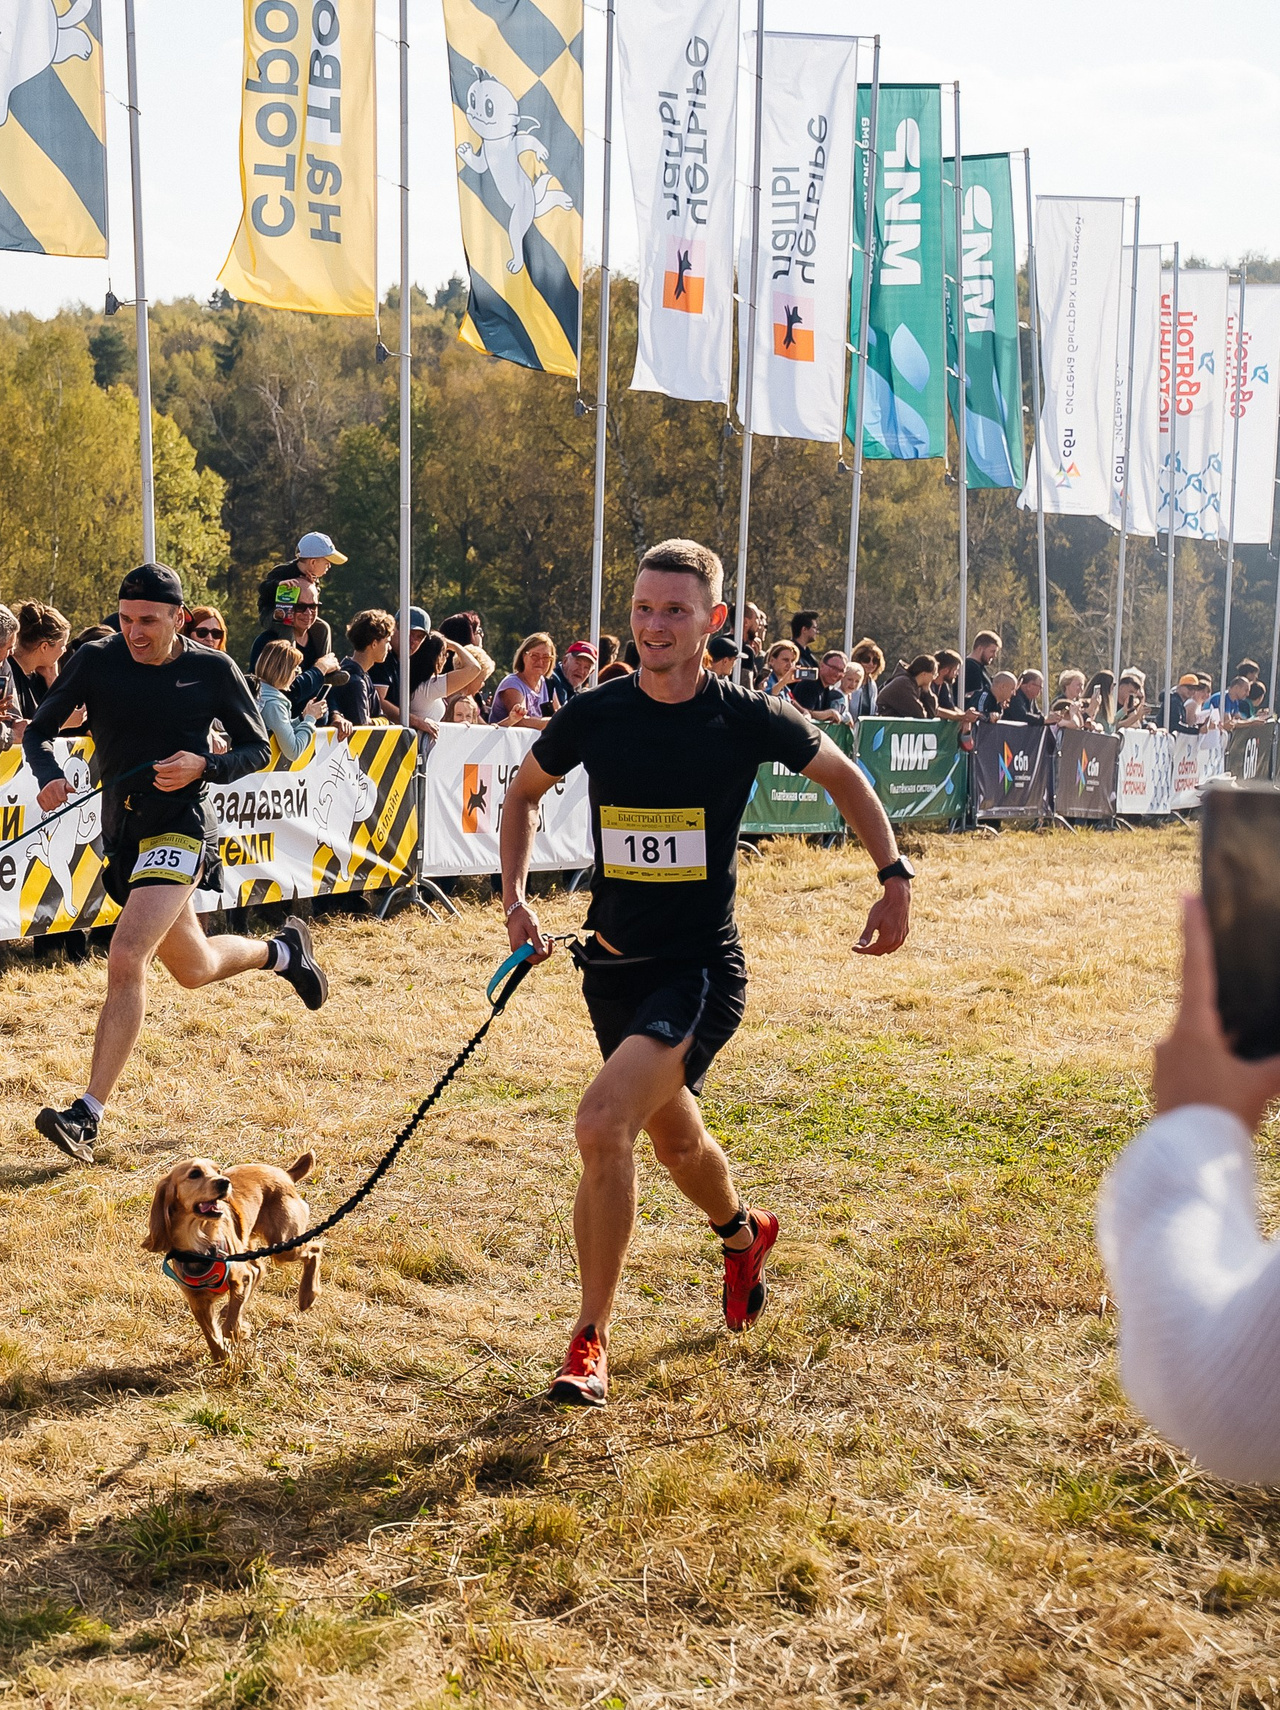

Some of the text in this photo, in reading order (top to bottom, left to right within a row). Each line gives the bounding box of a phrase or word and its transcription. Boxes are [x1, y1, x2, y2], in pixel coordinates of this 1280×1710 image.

[890, 733, 938, 771] МИР
[1013, 750, 1029, 771] сбп
[213, 779, 308, 829] задавай
[618, 813, 663, 824] БЫСТРЫЙ
[143, 848, 182, 868] 235
[624, 835, 677, 864] 181
